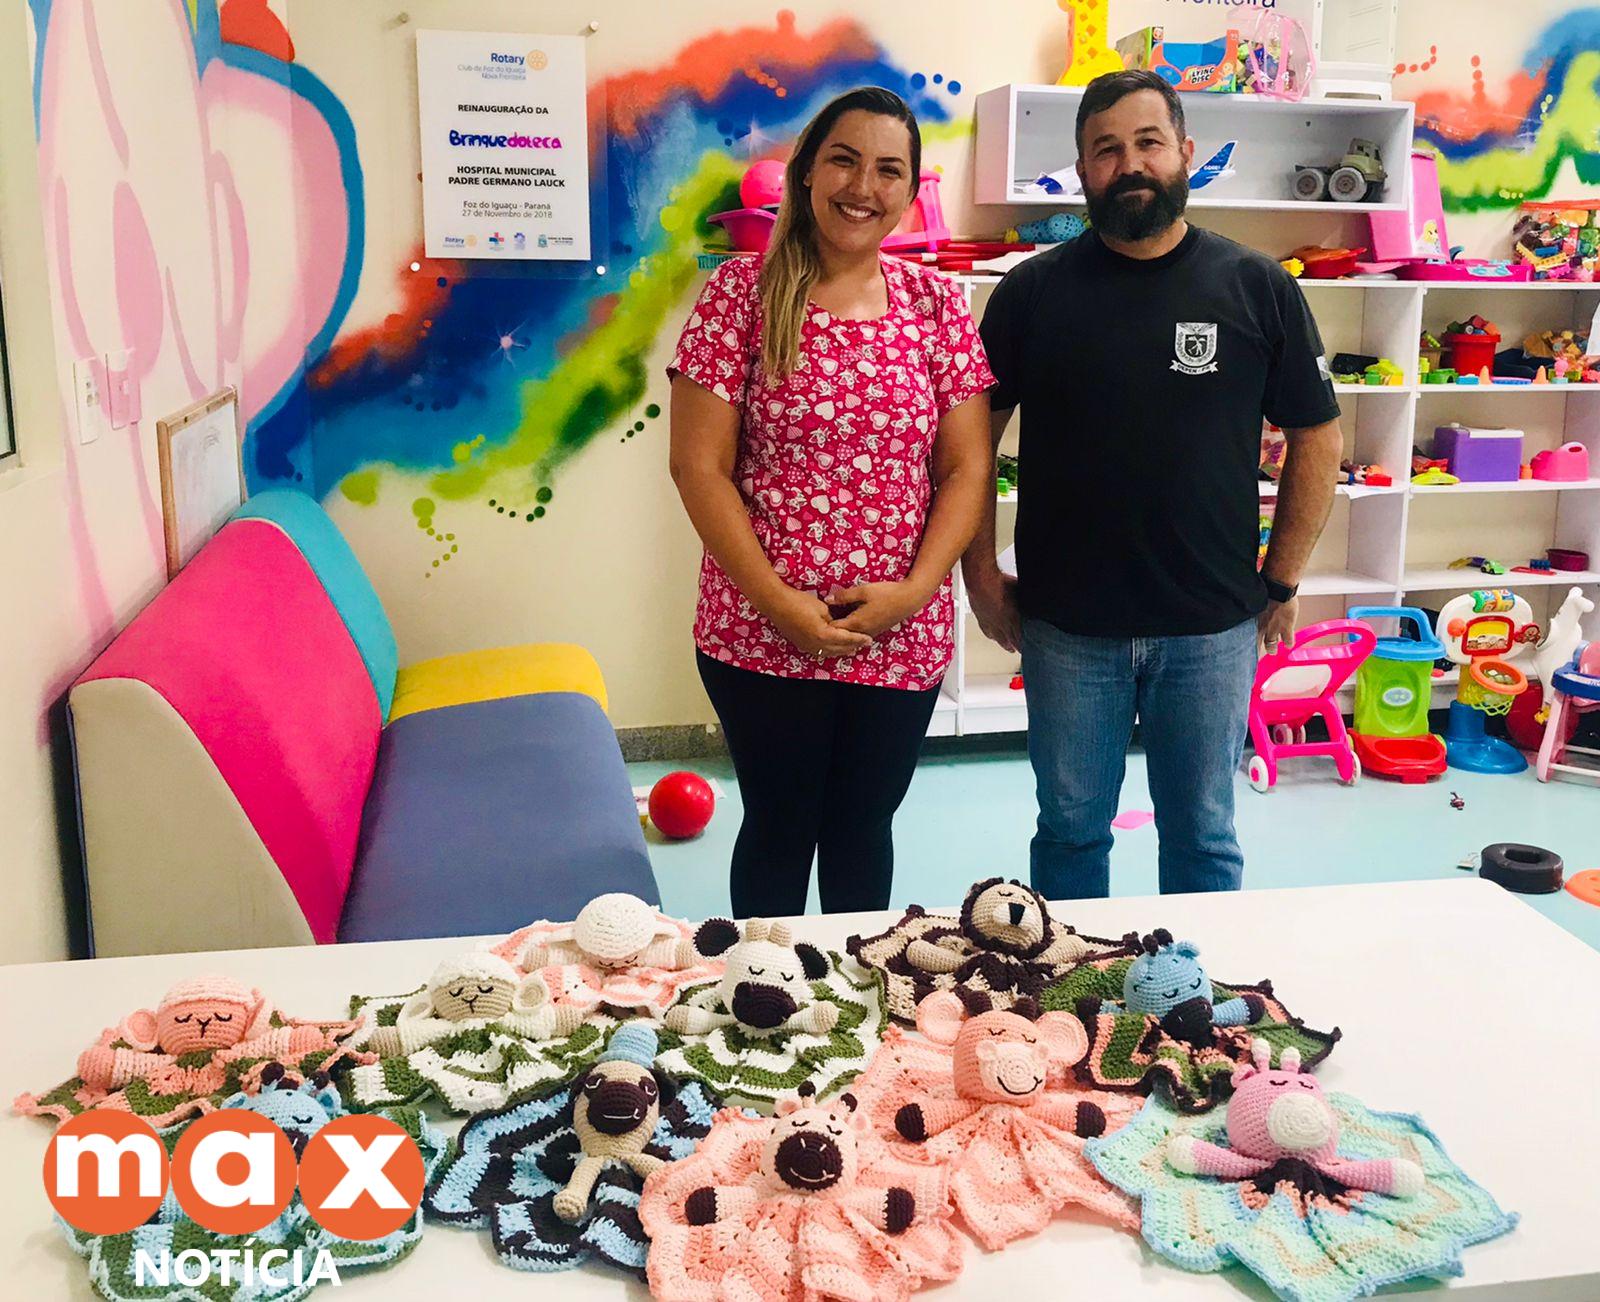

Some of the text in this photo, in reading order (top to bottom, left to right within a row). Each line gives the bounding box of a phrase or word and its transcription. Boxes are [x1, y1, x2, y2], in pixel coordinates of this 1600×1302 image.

[491, 53, 525, 65] Rotary
[457, 104, 533, 115] REINAUGURAÇÃO
[449, 129, 562, 149] Brinquedoteca
[457, 166, 556, 176] HOSPITAL MUNICIPAL
[448, 176, 565, 188] PADRE GERMANO LAUCK
[463, 200, 477, 208] Foz
[479, 201, 489, 209] do
[491, 201, 518, 211] Iguaçu
[462, 209, 472, 217] 27
[473, 209, 483, 217] de
[484, 210, 521, 218] Novembro
[522, 210, 532, 218] de
